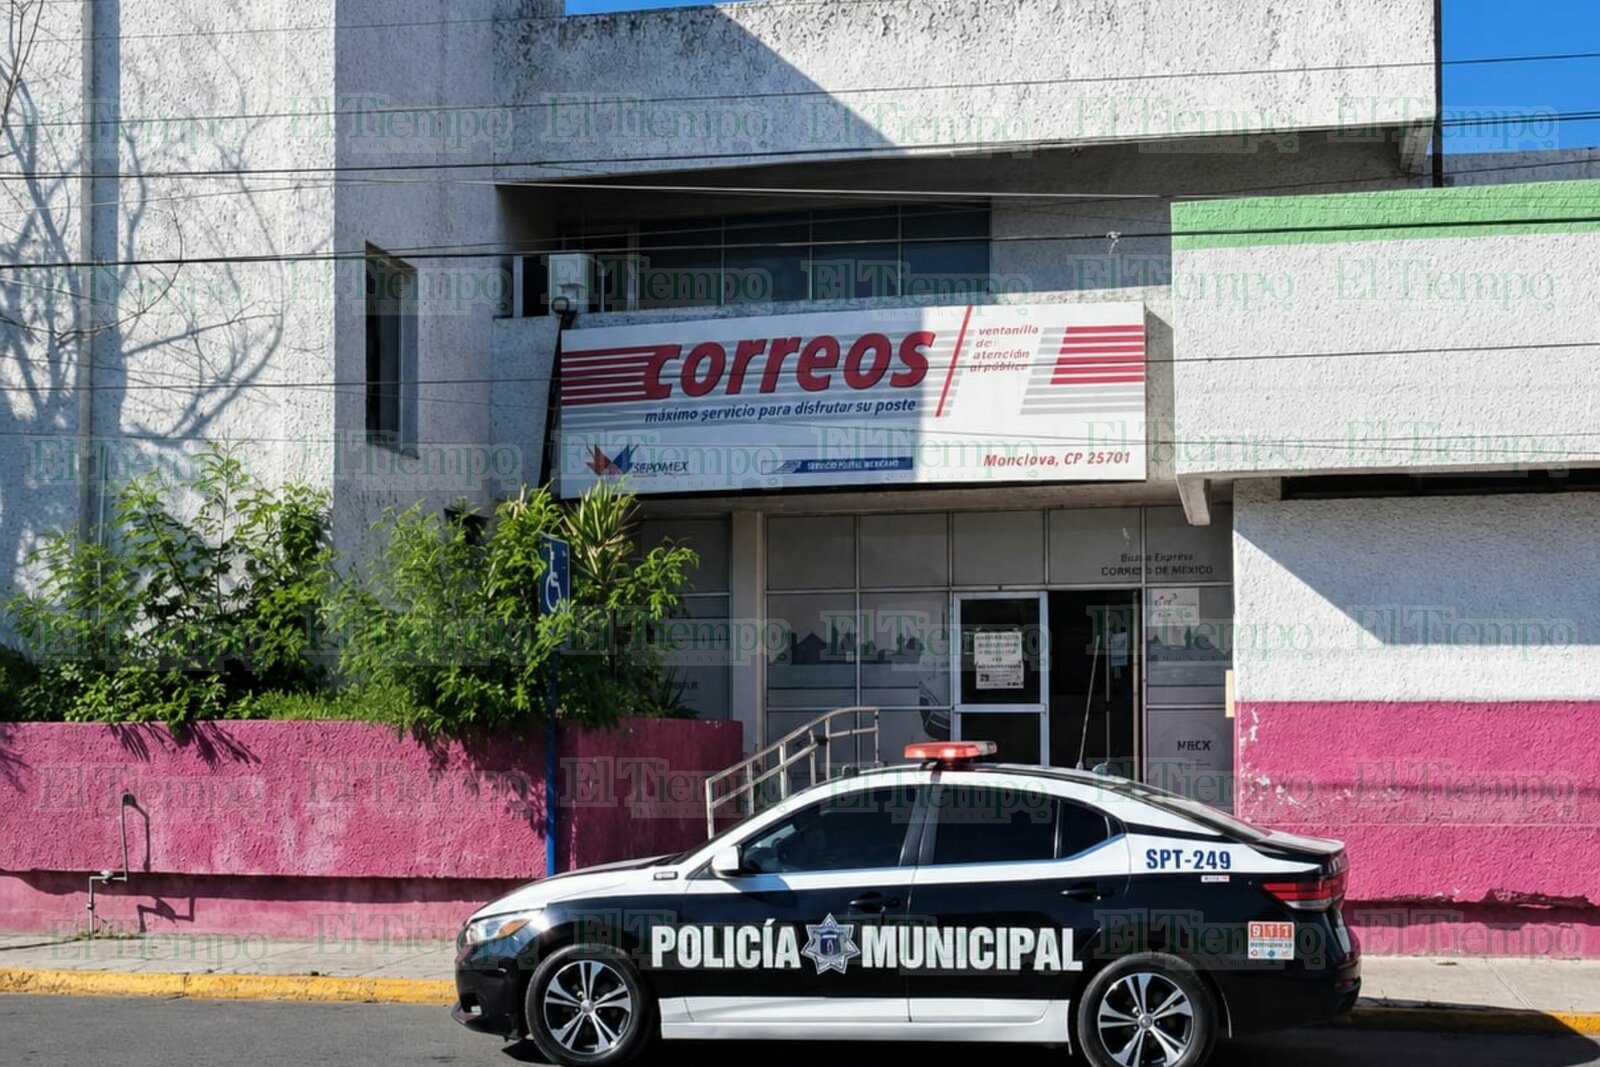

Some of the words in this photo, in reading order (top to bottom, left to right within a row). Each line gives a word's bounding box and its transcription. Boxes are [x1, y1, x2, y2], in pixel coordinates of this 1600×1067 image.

[978, 324, 1039, 336] ventanilla
[975, 338, 992, 348] de
[972, 349, 1030, 360] atención
[643, 331, 936, 399] correos
[645, 406, 697, 423] máximo
[701, 404, 755, 421] servicio
[758, 403, 791, 420] para
[795, 400, 853, 415] disfrutar
[856, 401, 872, 413] su
[874, 398, 916, 415] poste
[632, 460, 690, 474] SEPOMEX
[983, 453, 1059, 468] Monclova,
[1064, 453, 1083, 466] CP
[1087, 451, 1131, 465] 25701
[1145, 849, 1231, 870] SPT-249
[1251, 924, 1292, 938] 911
[651, 917, 802, 969] POLICÍA
[862, 926, 1083, 972] MUNICIPAL
